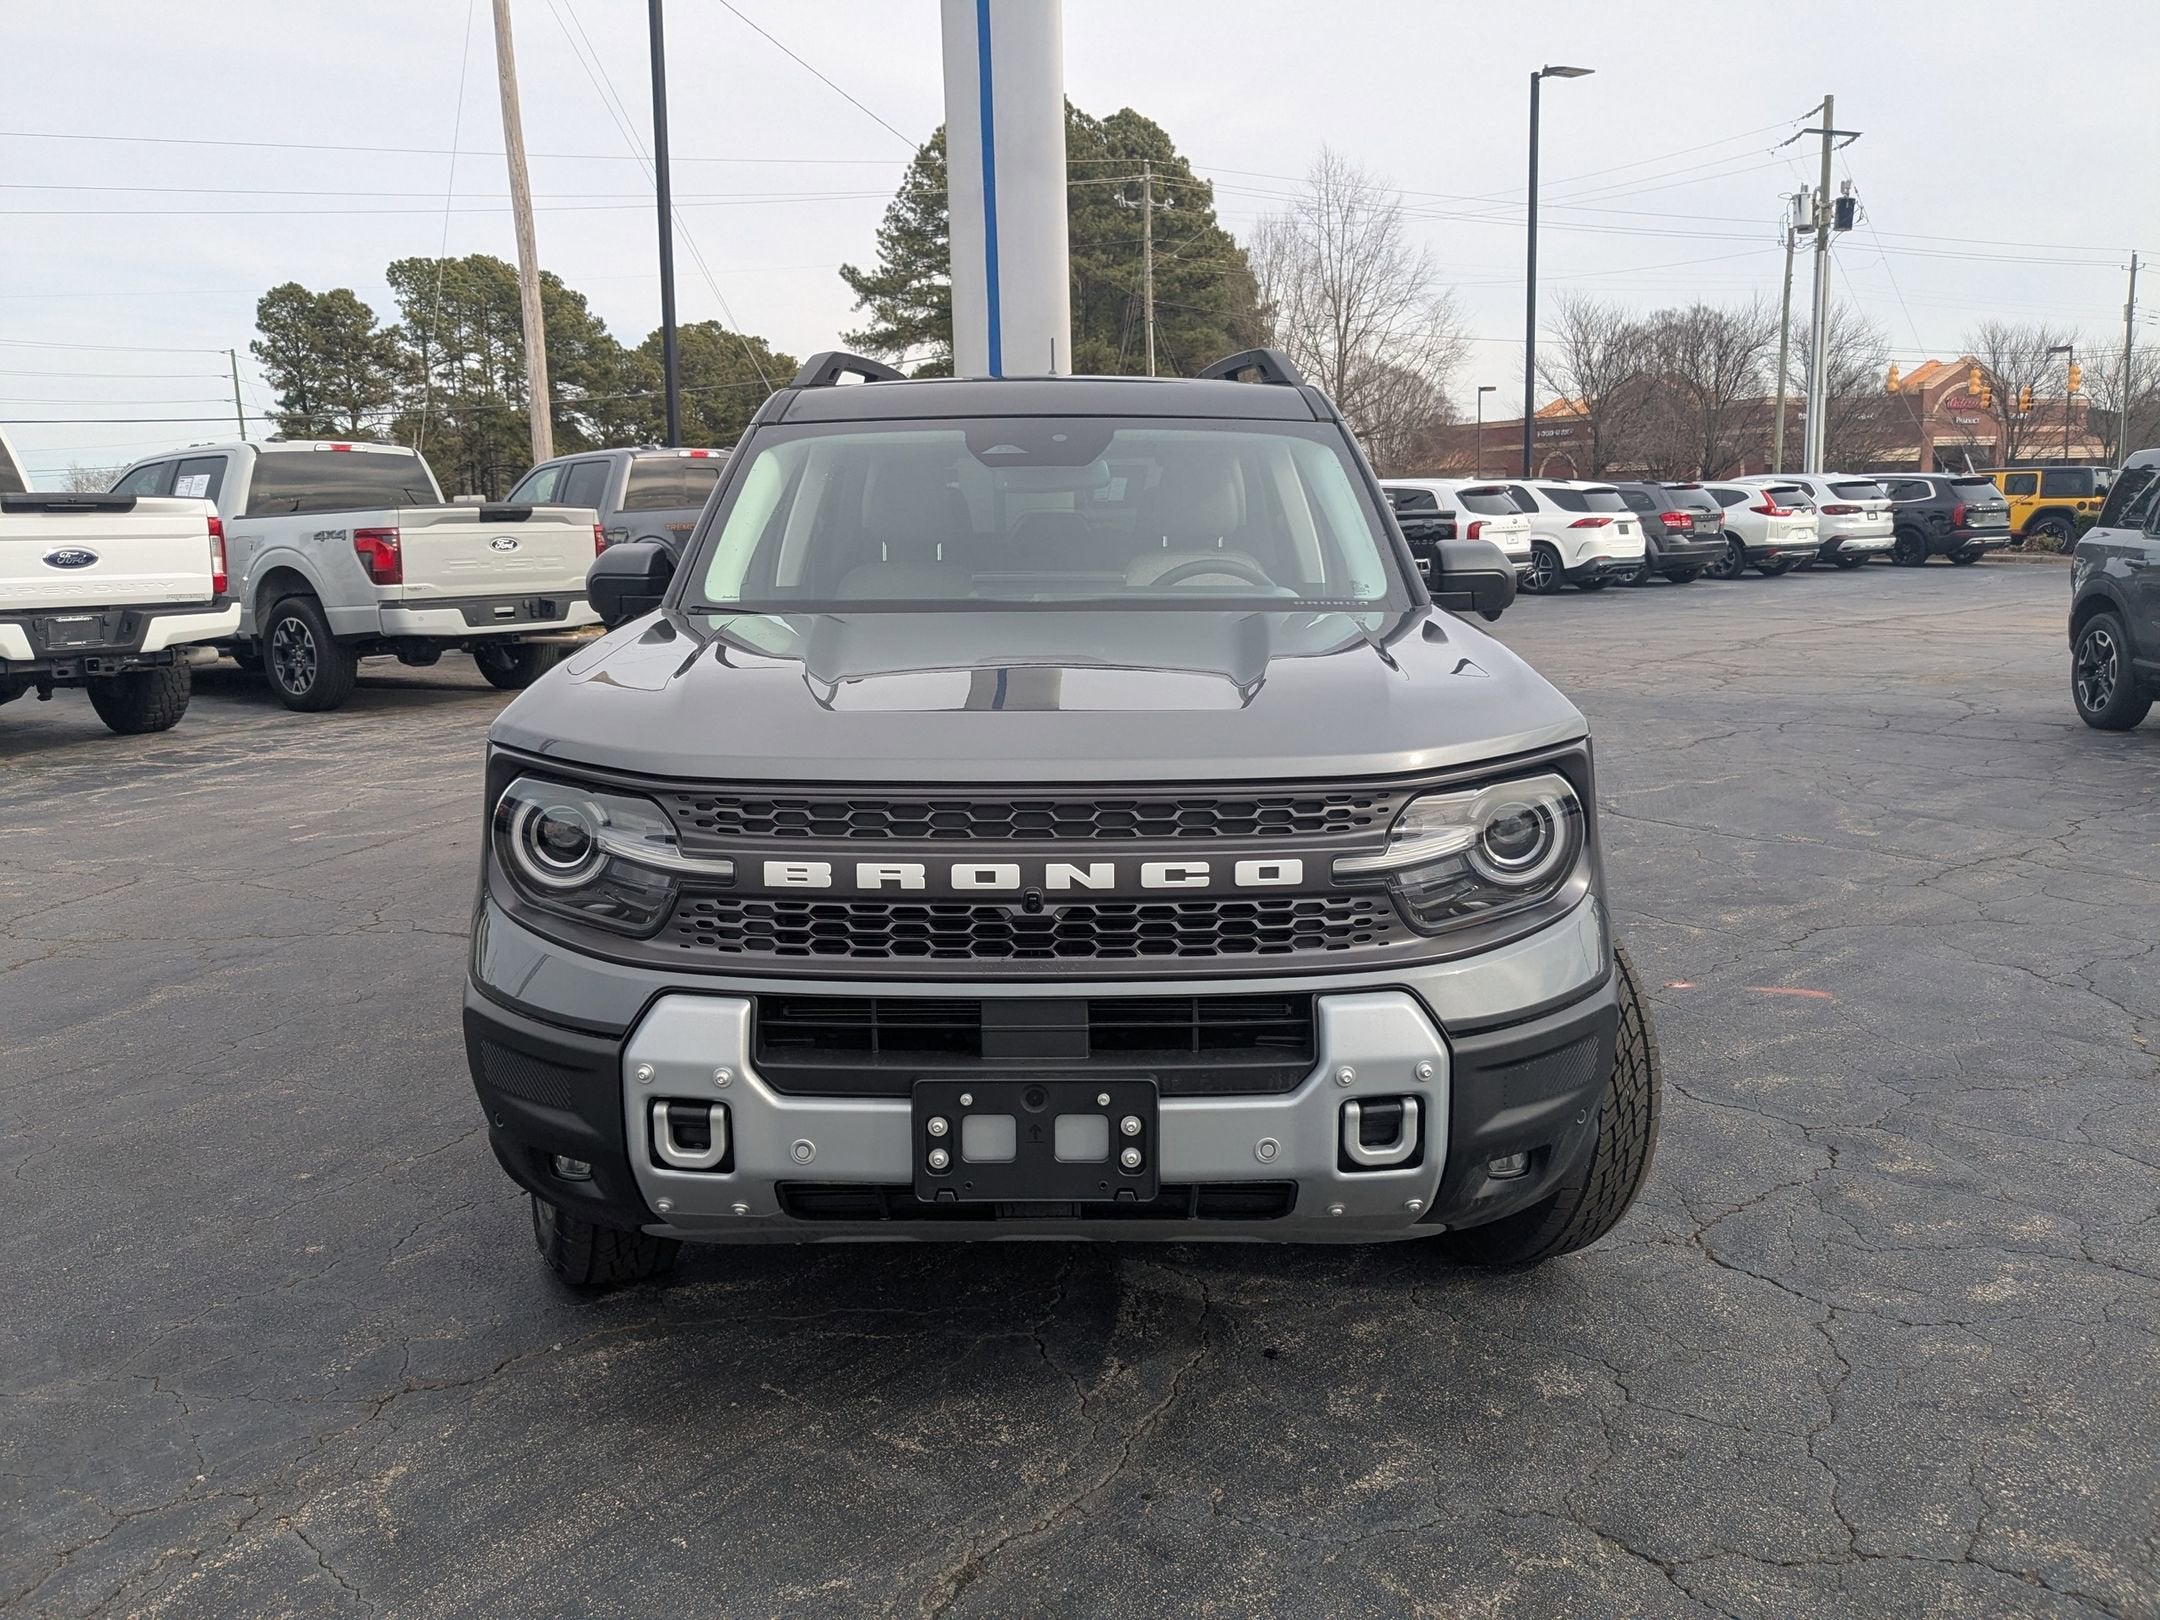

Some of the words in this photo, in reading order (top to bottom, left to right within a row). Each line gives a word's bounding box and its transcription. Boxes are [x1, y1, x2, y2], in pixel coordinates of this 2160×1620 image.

[664, 522, 697, 532] TREMO
[0, 584, 84, 598] UPER
[93, 582, 175, 594] DUTY
[763, 858, 1304, 890] BRONCO
